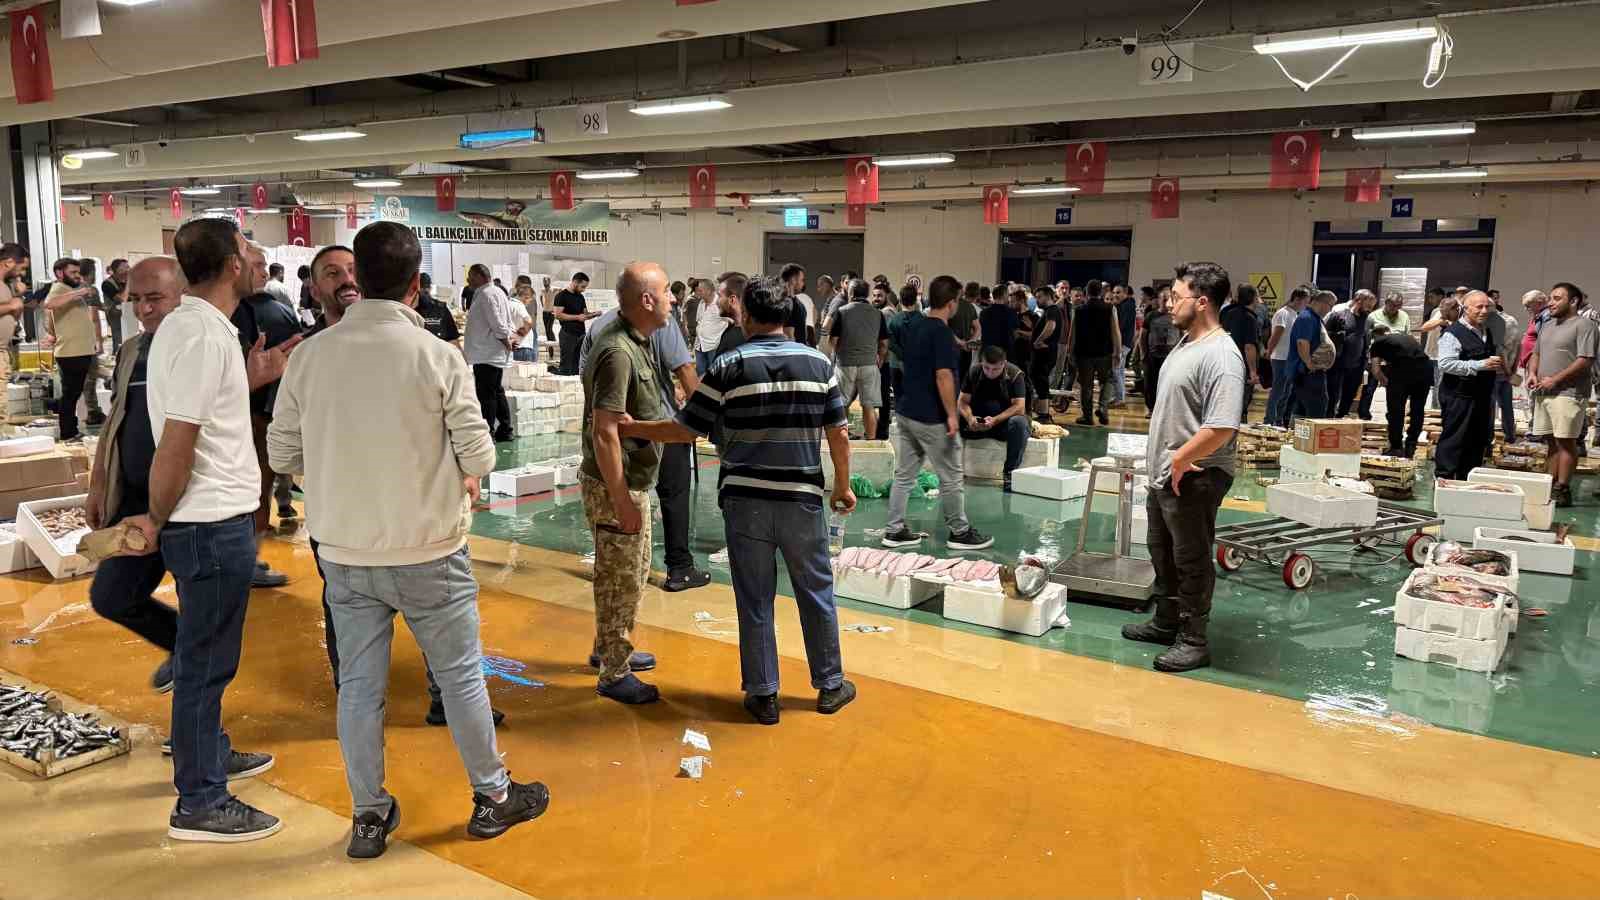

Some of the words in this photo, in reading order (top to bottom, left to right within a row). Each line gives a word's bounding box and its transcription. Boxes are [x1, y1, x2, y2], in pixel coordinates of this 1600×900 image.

[1151, 56, 1180, 80] 99
[583, 113, 600, 132] 98
[129, 150, 139, 161] 97
[1394, 202, 1409, 213] 14
[425, 226, 485, 242] BALIKÇILIK
[487, 228, 526, 241] HAYIRLI
[529, 229, 578, 242] SEZONLAR
[581, 228, 607, 242] DİLER
